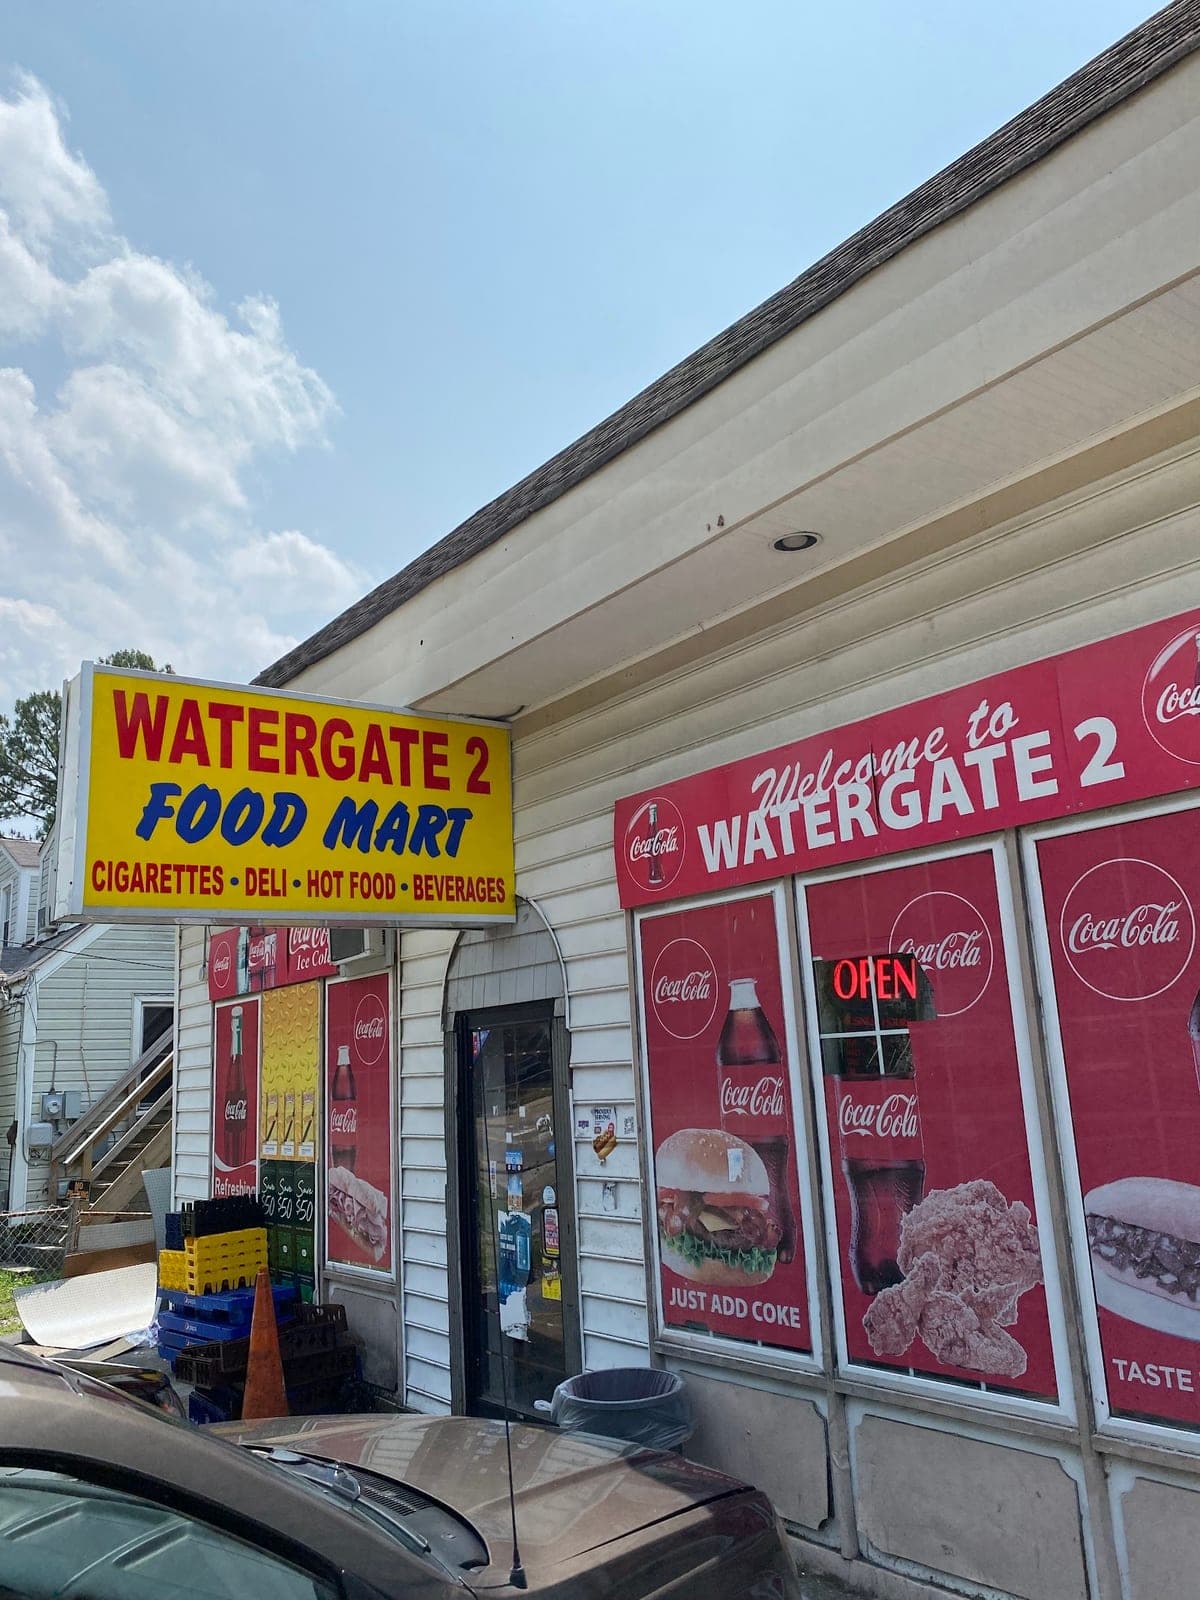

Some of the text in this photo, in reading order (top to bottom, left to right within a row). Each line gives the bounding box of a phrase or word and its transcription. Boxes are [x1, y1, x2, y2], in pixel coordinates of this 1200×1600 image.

[113, 689, 491, 795] WATERGATE 2
[752, 699, 1019, 816] Welcome to
[697, 717, 1125, 873] WATERGATE 2
[135, 783, 473, 858] FOOD MART
[630, 826, 678, 861] Coca-Cola
[92, 860, 506, 903] CIGARETTES DELI HOT FOOD BEVERAGES
[1068, 901, 1182, 953] Coca-Cola
[296, 948, 331, 970] Ice Col
[833, 959, 917, 999] OPEN
[655, 971, 712, 1003] Coca-Cola
[720, 1077, 783, 1117] Coca-Cola
[840, 1094, 918, 1137] Coca-Cola
[670, 1287, 800, 1329] JUST ADD COKE
[1112, 1358, 1194, 1392] TASTE
